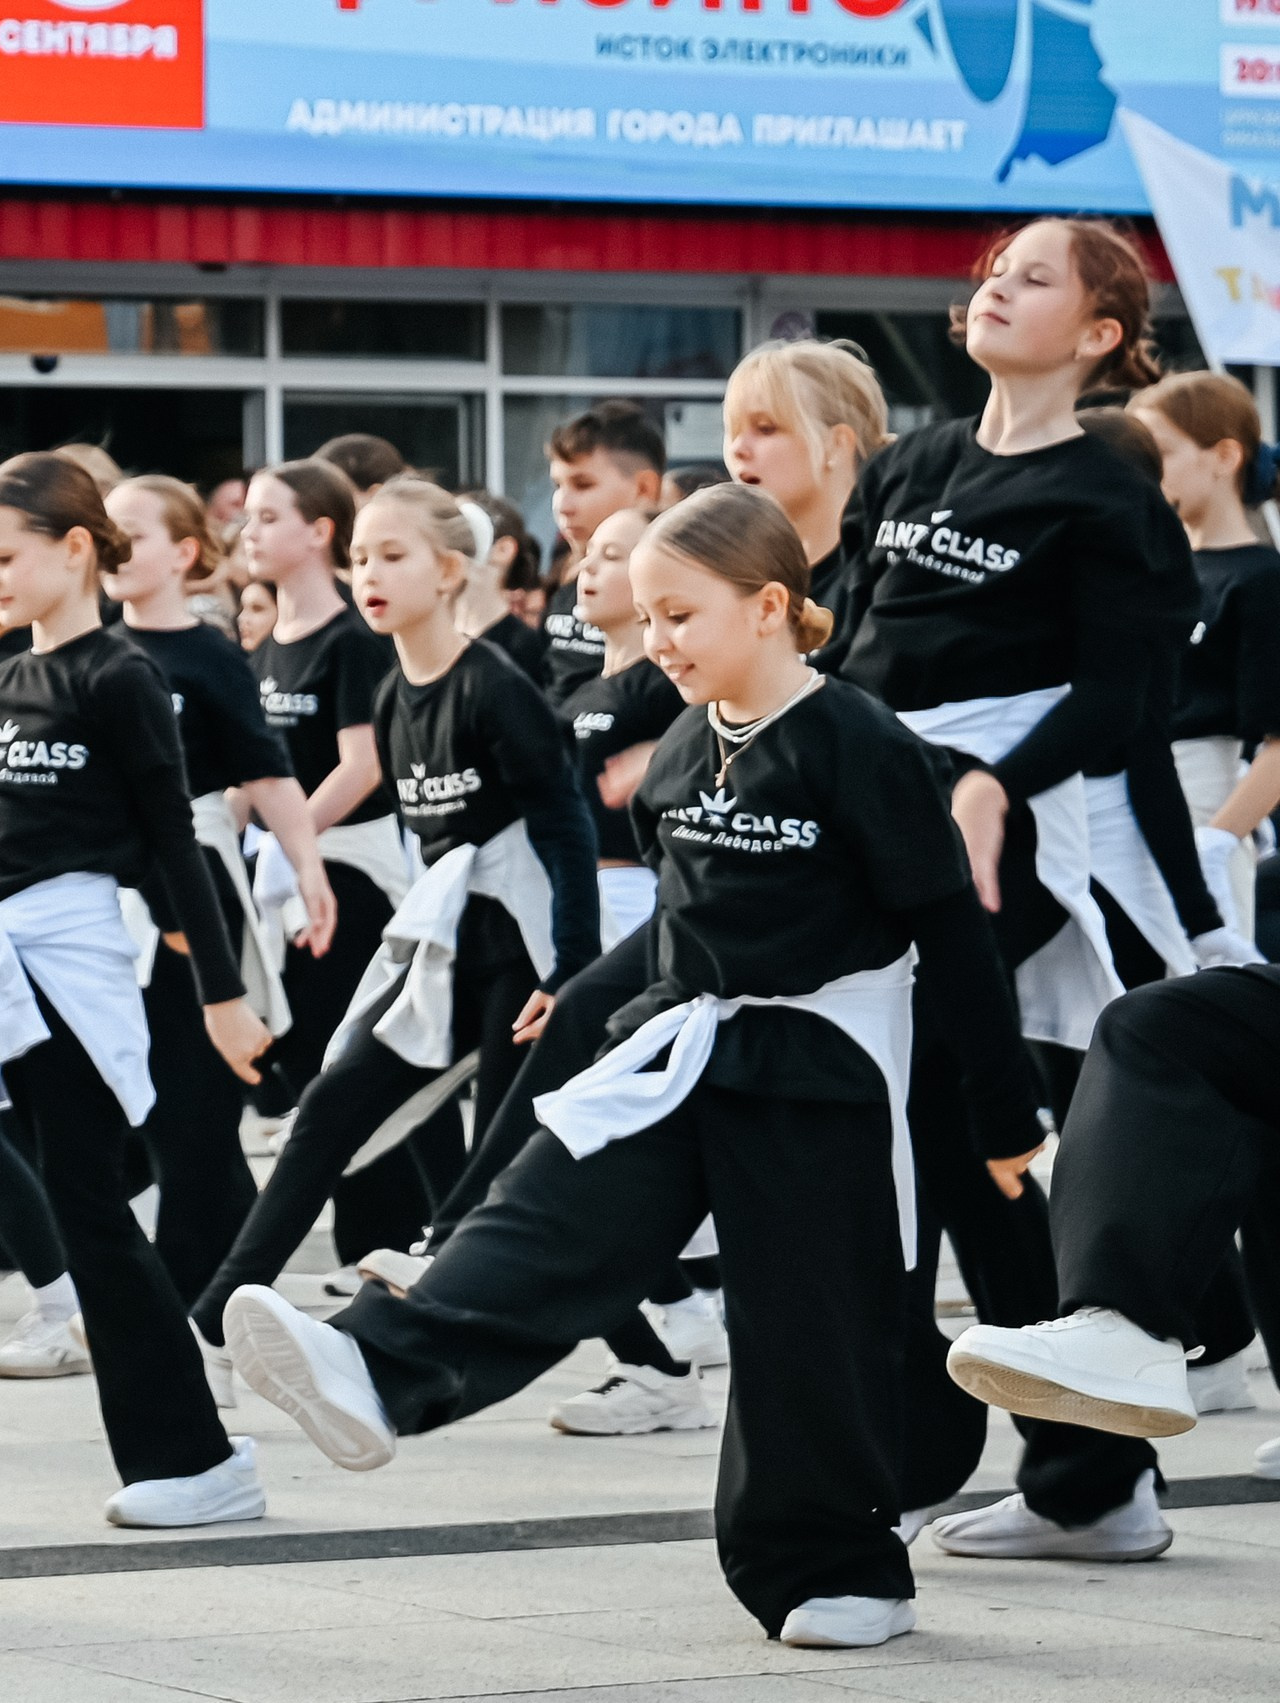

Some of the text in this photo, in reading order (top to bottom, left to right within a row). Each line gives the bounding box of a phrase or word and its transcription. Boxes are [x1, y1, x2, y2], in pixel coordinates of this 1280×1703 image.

[595, 33, 911, 66] ИСТОК ЭЛЕКТРОНИКИ
[285, 98, 967, 150] АДМИНИСТРАЦИЯ ГОРОДА ПРИГЛАШАЕТ
[931, 527, 1020, 572] CLASS
[7, 740, 88, 769] CLASS
